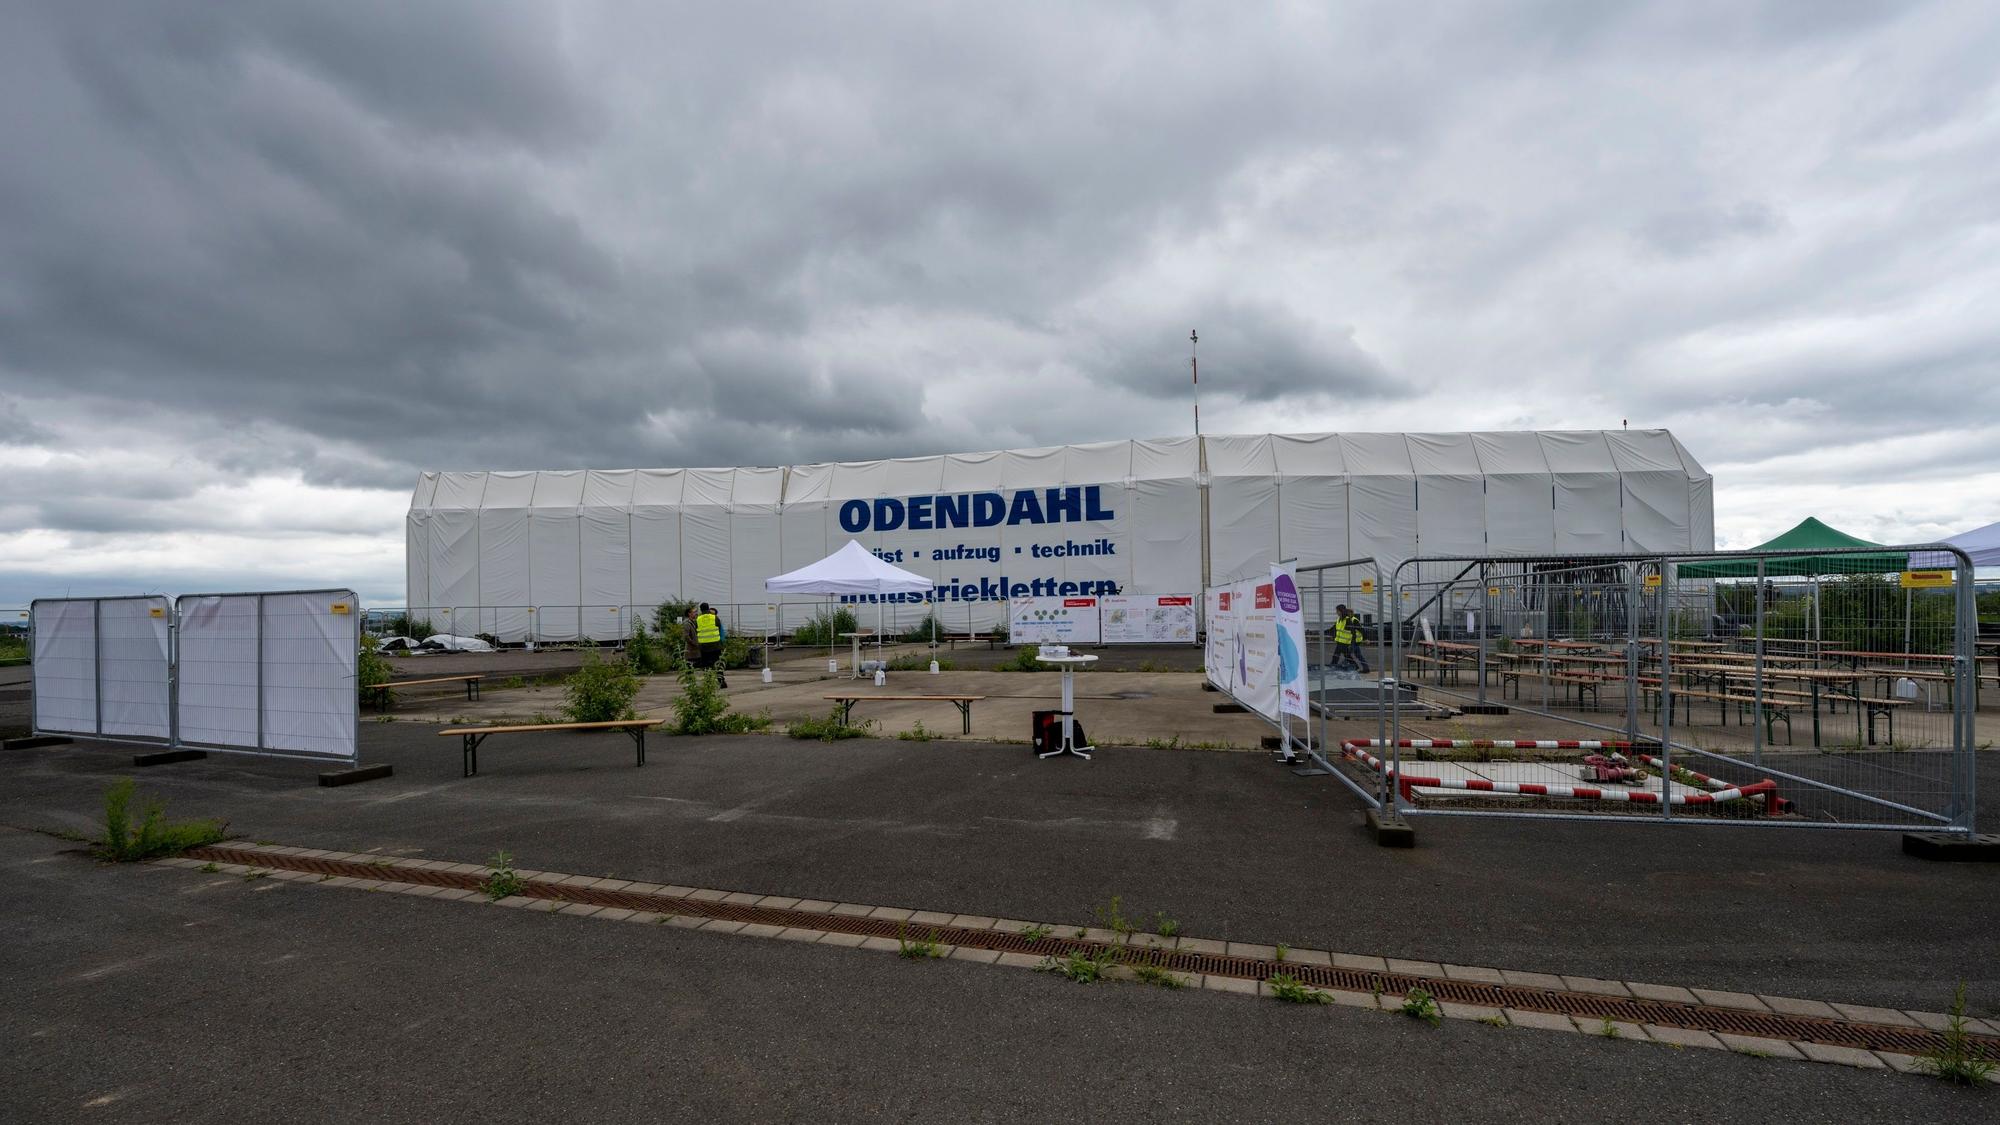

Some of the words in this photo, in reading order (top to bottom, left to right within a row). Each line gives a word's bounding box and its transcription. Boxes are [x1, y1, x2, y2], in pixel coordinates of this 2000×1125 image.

[839, 485, 1115, 533] ODENDAHL
[932, 543, 1001, 563] aufzug
[1031, 538, 1116, 558] technik
